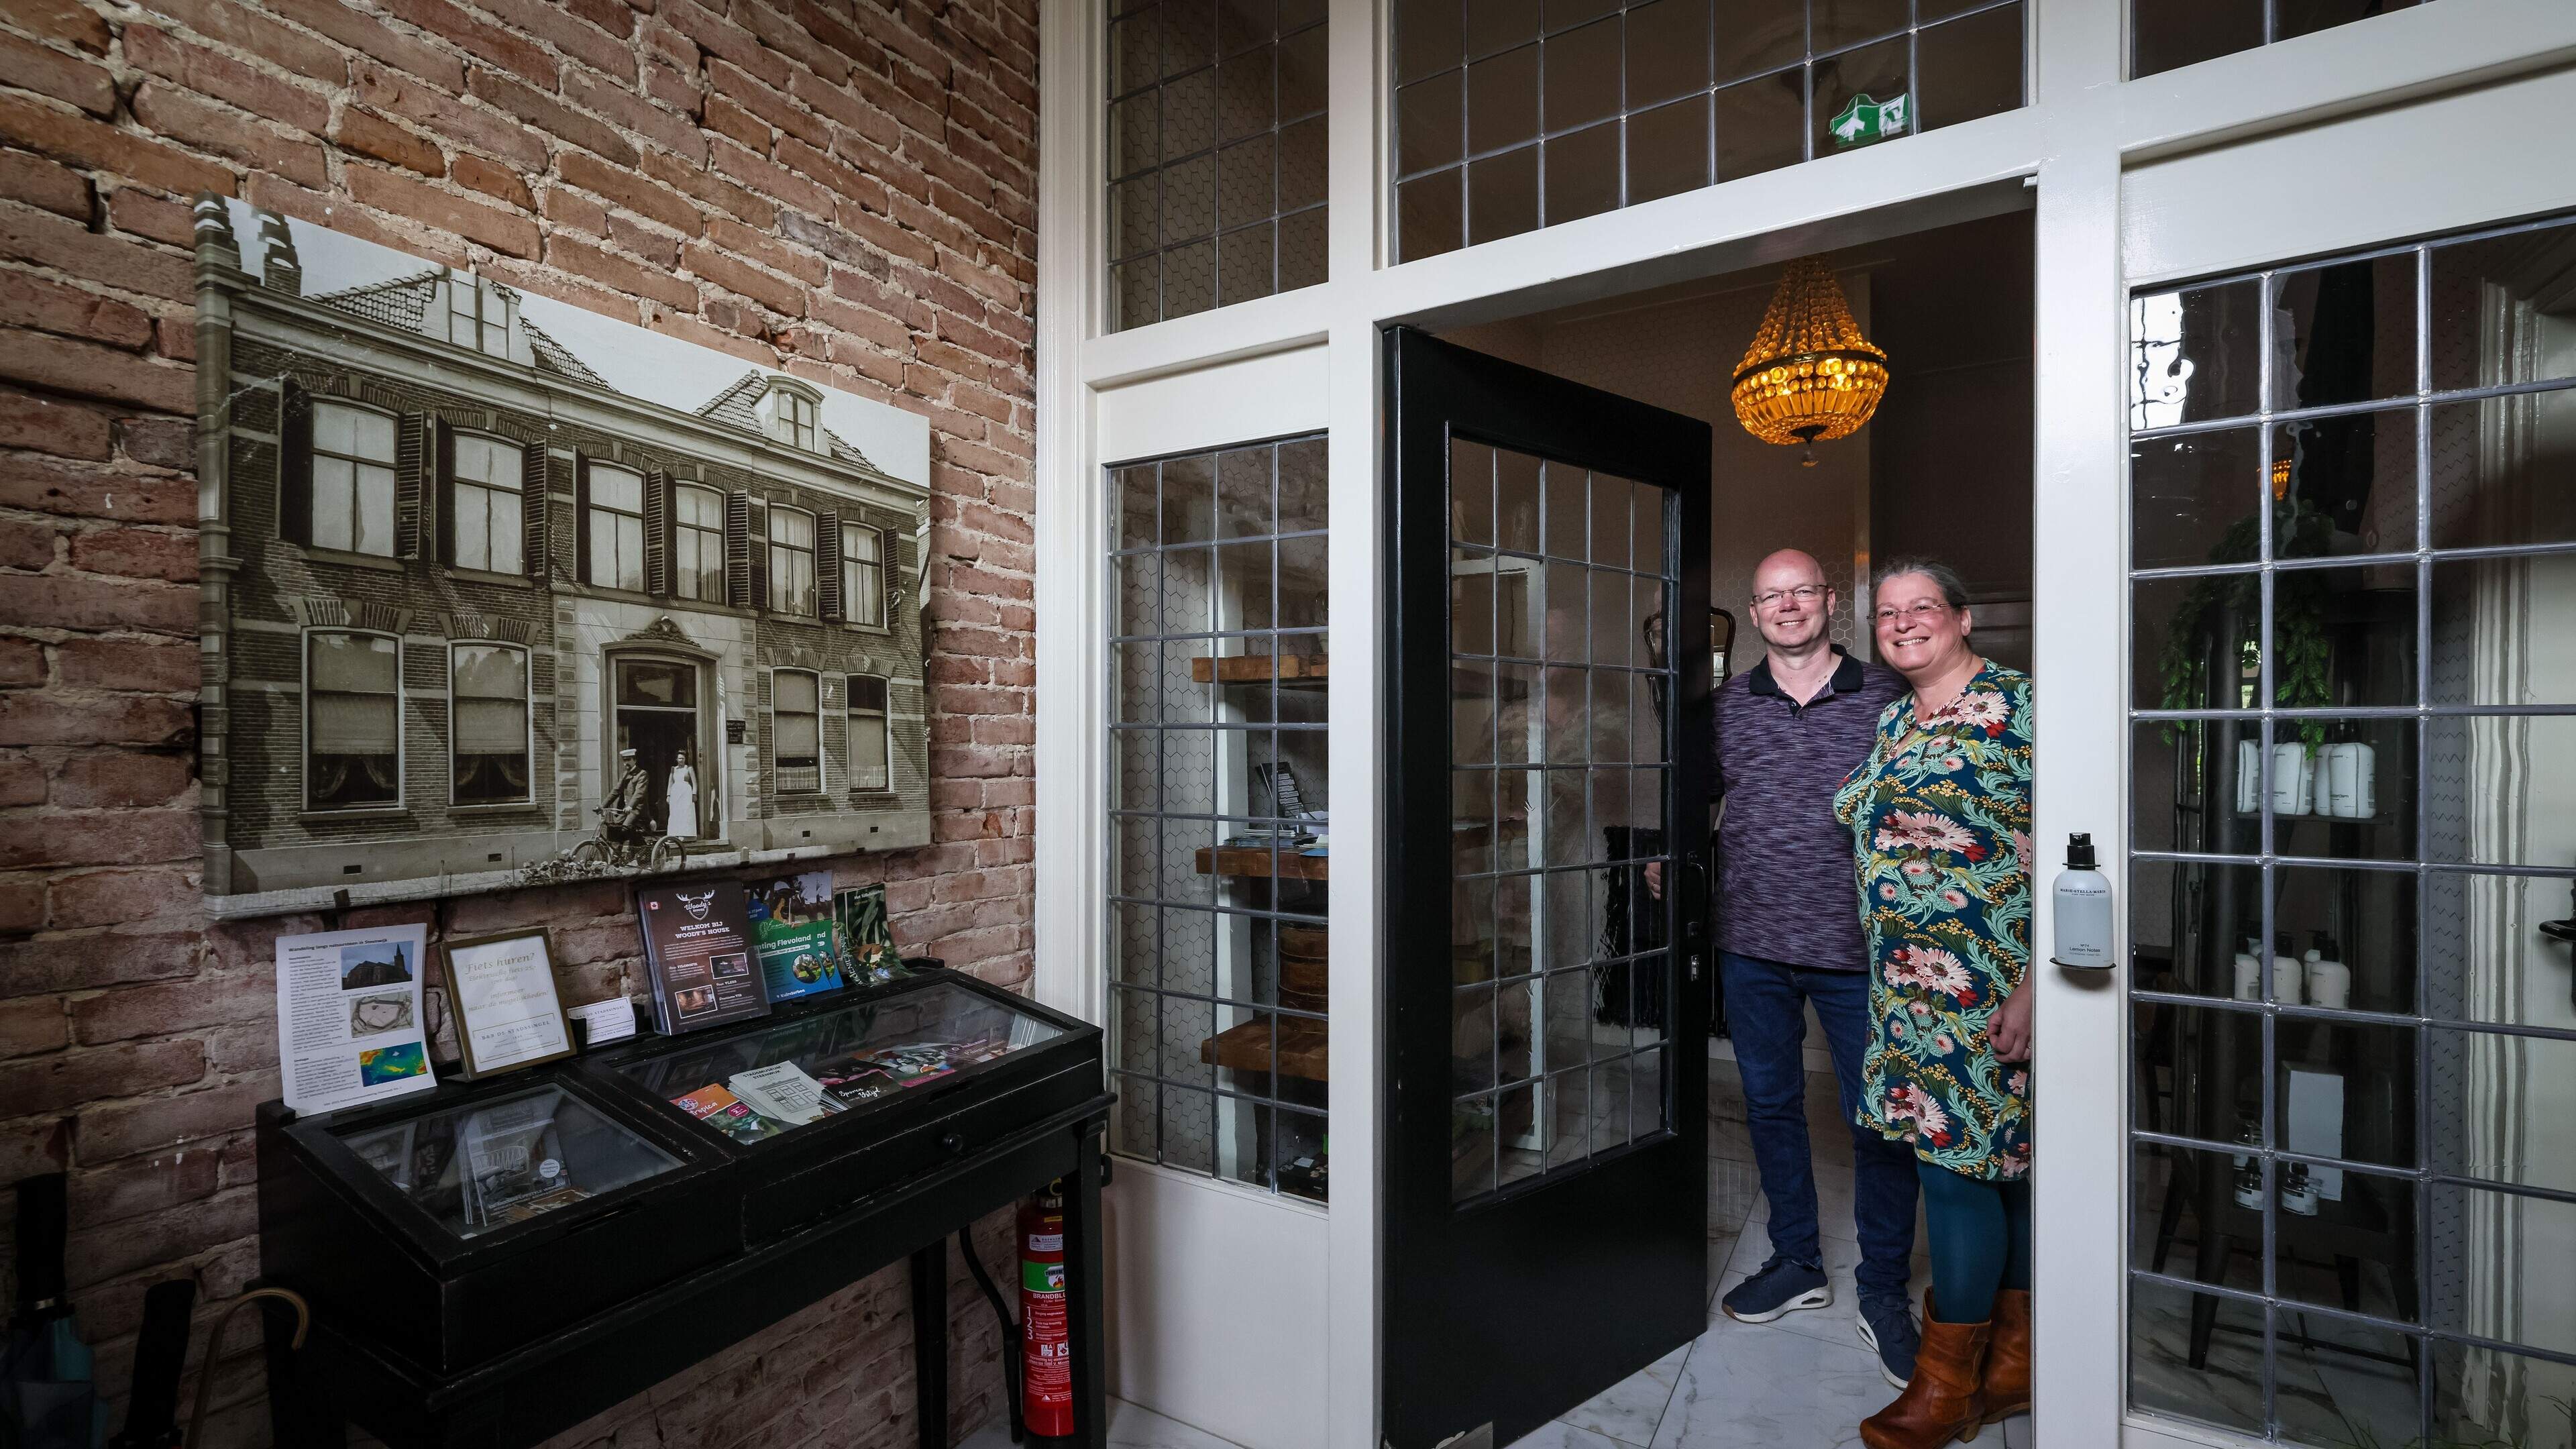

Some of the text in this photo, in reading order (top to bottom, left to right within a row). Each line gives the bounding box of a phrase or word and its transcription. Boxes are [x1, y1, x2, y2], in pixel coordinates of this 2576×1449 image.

[684, 899, 712, 911] Woody's
[680, 923, 710, 931] WELKOM
[676, 930, 706, 938] WOODY'S
[777, 934, 812, 947] Flevoland
[465, 953, 535, 974] Fiets huren?
[743, 1065, 782, 1077] STADSMUSEUM
[753, 1070, 780, 1079] STEENWIJK
[839, 1087, 863, 1097] Sporen
[1027, 1306, 1031, 1317] 1
[1027, 1317, 1032, 1328] 2
[1027, 1328, 1032, 1340] 3
